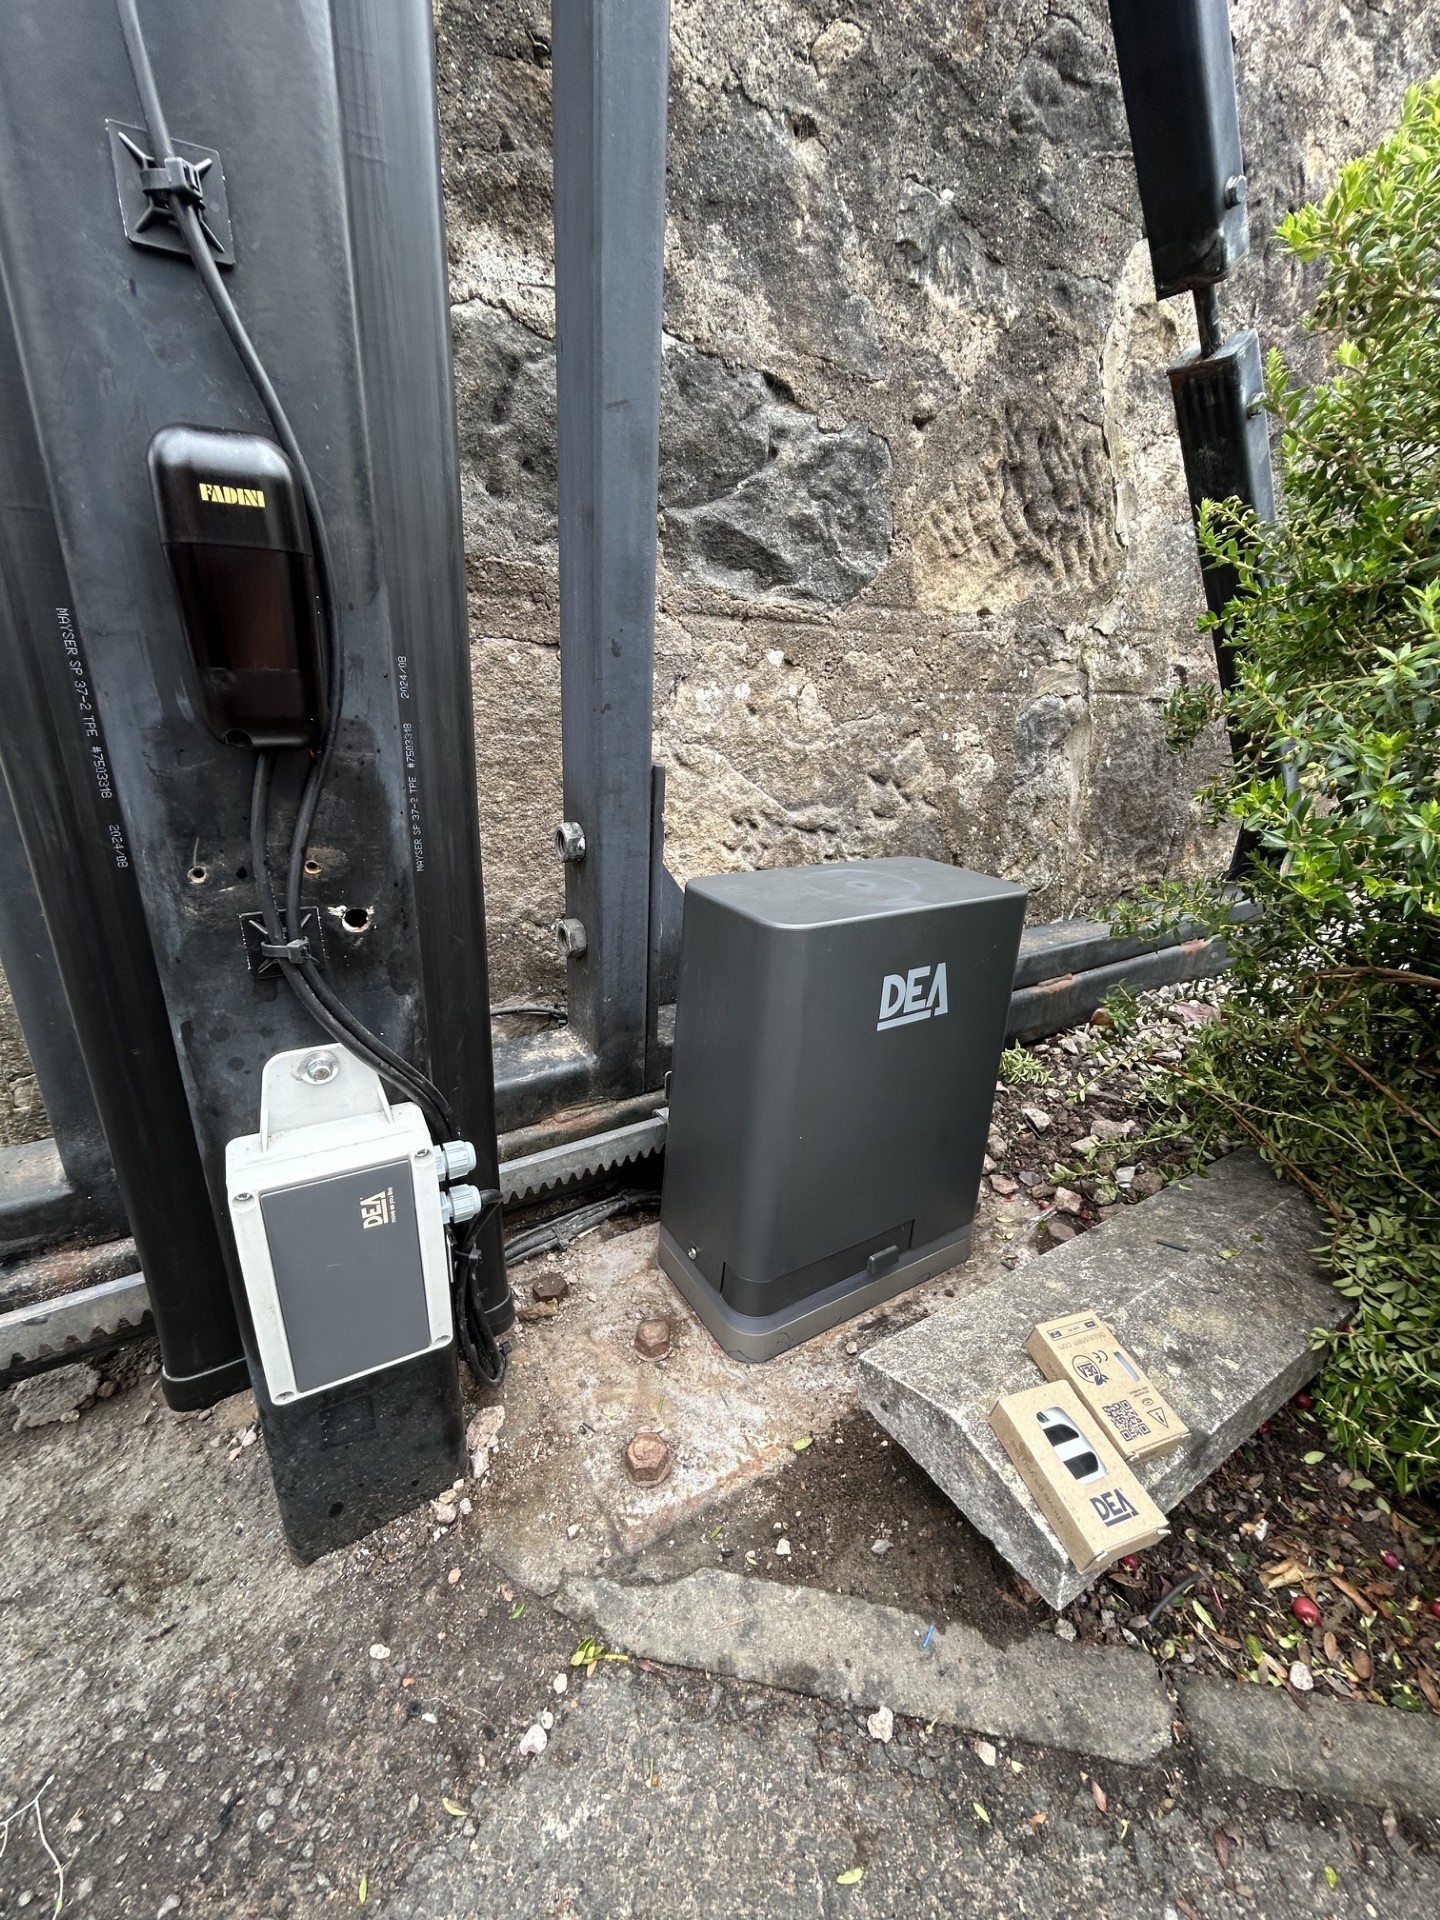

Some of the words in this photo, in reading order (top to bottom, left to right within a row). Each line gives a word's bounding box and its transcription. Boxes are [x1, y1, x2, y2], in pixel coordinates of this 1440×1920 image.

[199, 483, 266, 509] FADINI
[56, 607, 78, 655] MAYSER
[69, 660, 83, 676] SP
[397, 655, 410, 699] 2024/08
[74, 680, 92, 711] 37-2
[83, 715, 98, 737] TPE
[403, 723, 415, 769] #7503318
[91, 746, 113, 799] #7503318
[408, 776, 418, 794] TPE
[410, 797, 420, 821] 37-2
[109, 824, 129, 868] 2024/08
[414, 838, 425, 872] MAYSER
[877, 962, 948, 1031] DEA
[360, 1190, 389, 1229] DEA
[1077, 1362, 1099, 1378] DEA
[1089, 1488, 1140, 1527] DEA
